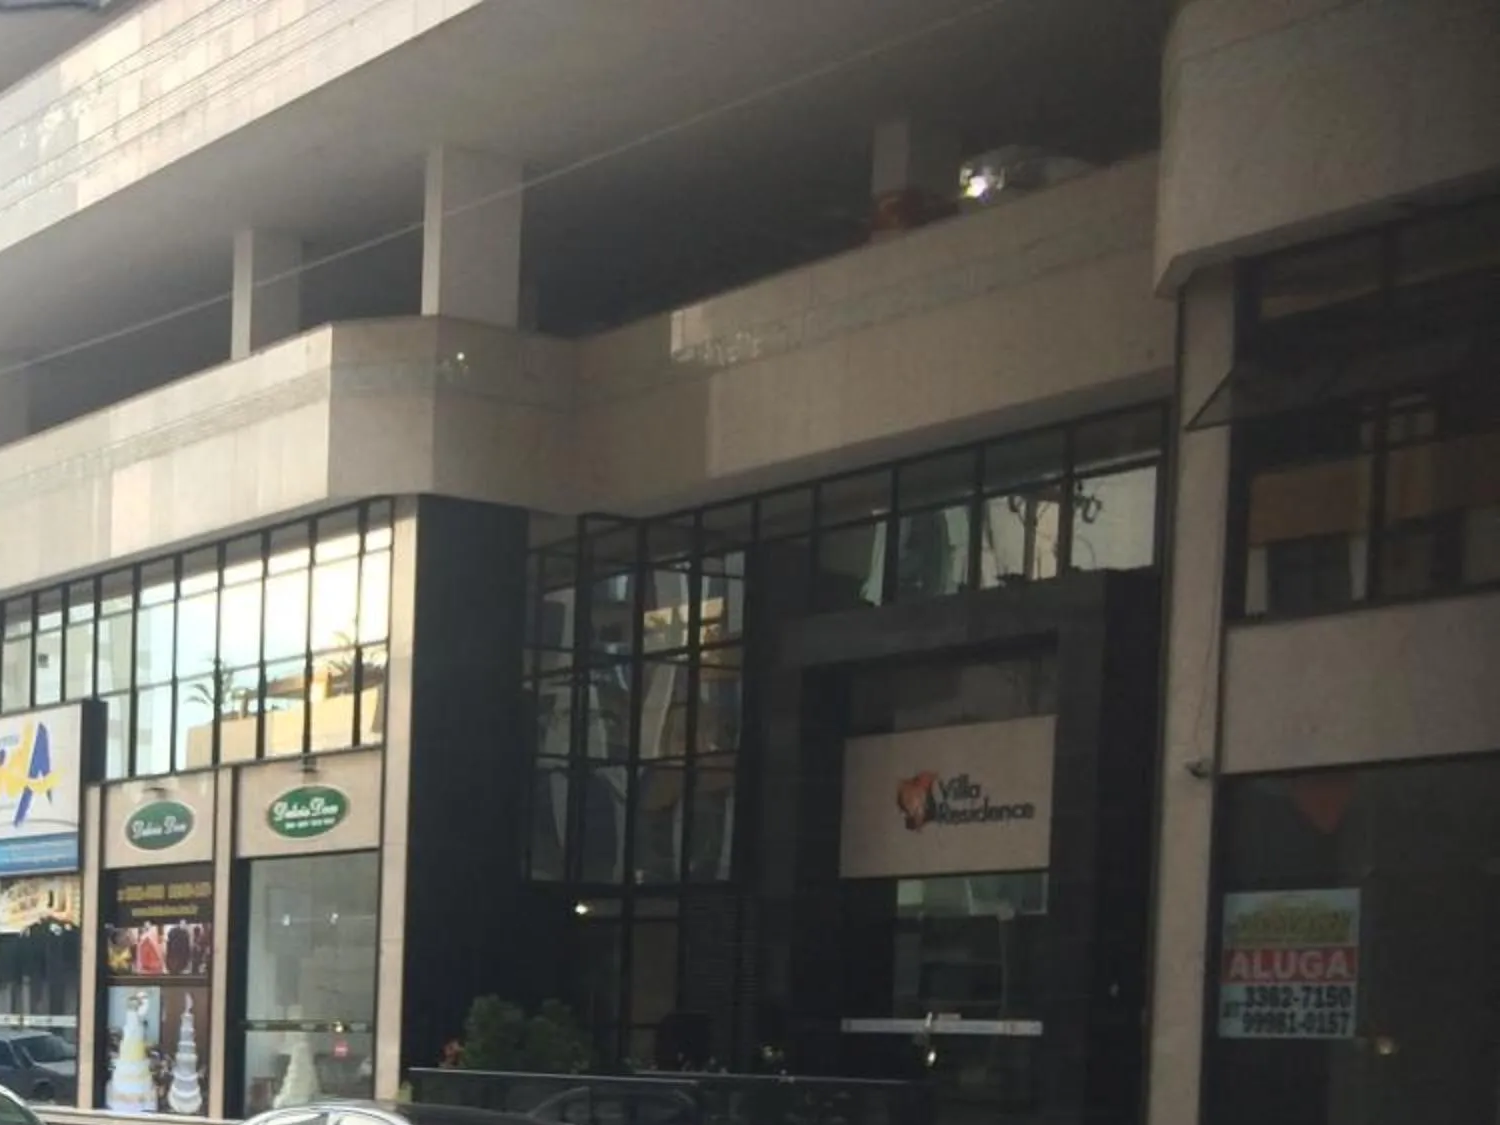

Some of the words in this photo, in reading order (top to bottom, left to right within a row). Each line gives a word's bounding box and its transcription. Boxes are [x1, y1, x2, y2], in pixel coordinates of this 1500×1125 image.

[938, 773, 981, 800] Villa
[936, 797, 1035, 825] Residence
[1229, 949, 1350, 980] ALUGA
